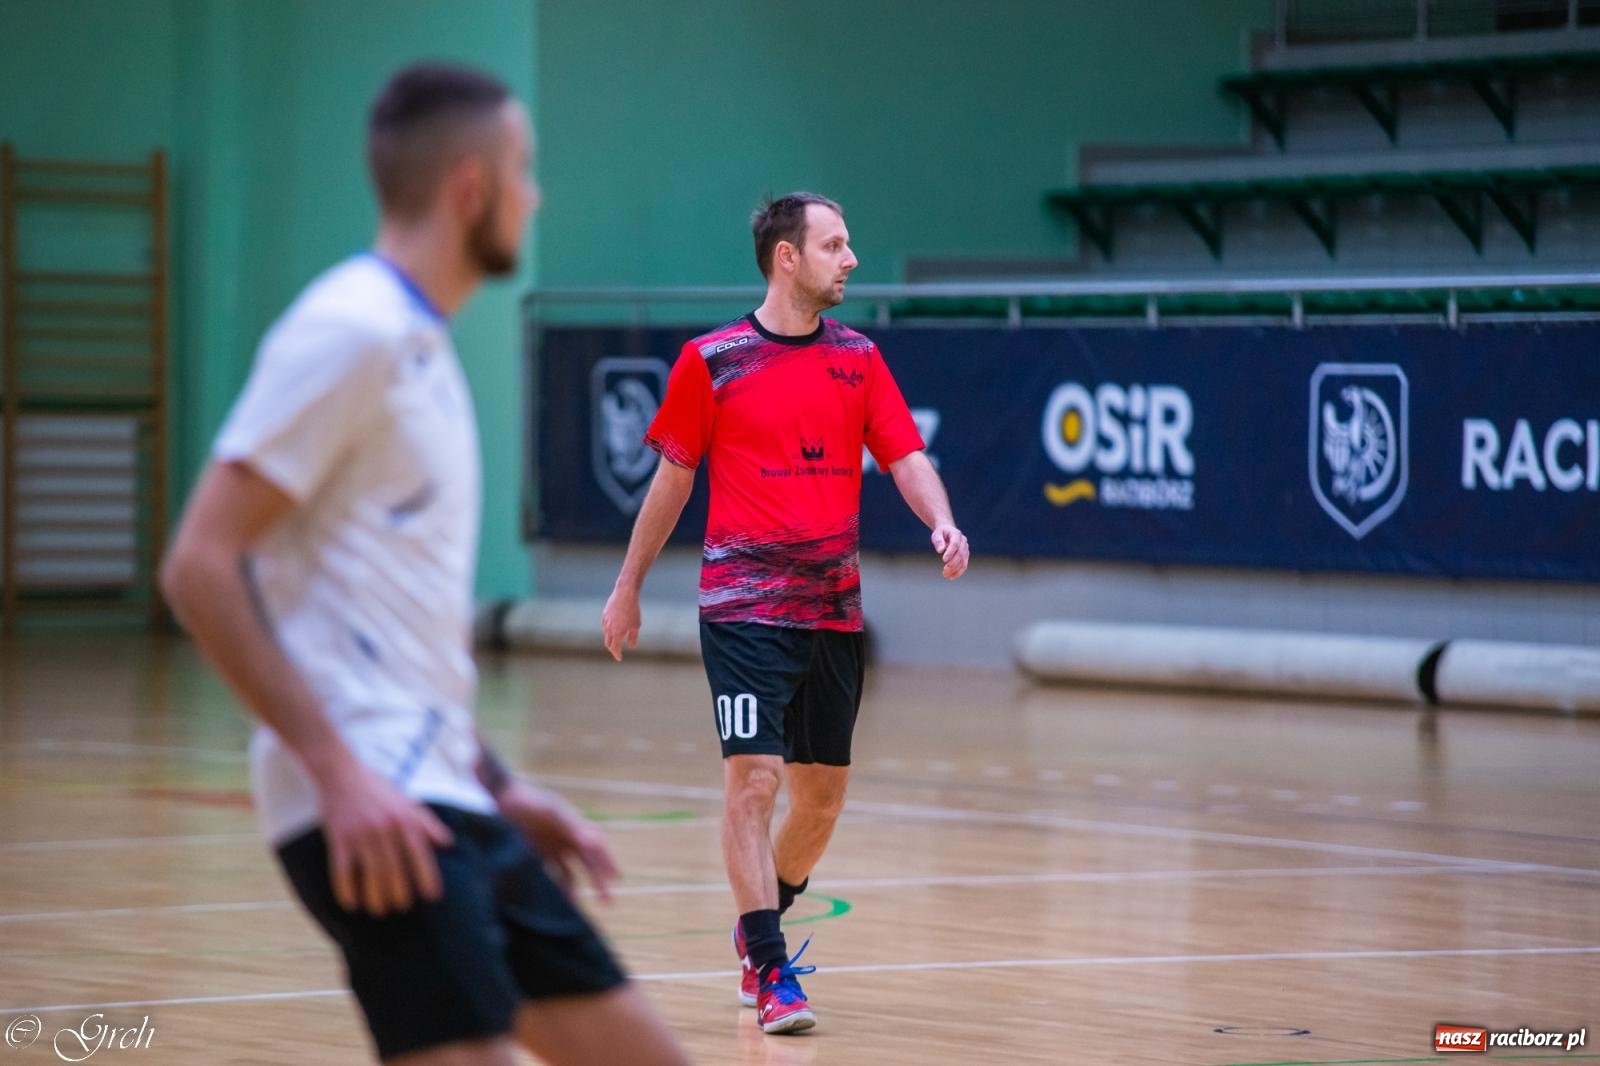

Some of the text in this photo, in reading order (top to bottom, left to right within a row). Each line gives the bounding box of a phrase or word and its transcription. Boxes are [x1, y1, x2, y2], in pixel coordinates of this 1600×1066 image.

[716, 338, 748, 353] COLO
[1461, 417, 1600, 492] RACI
[717, 693, 757, 740] 00
